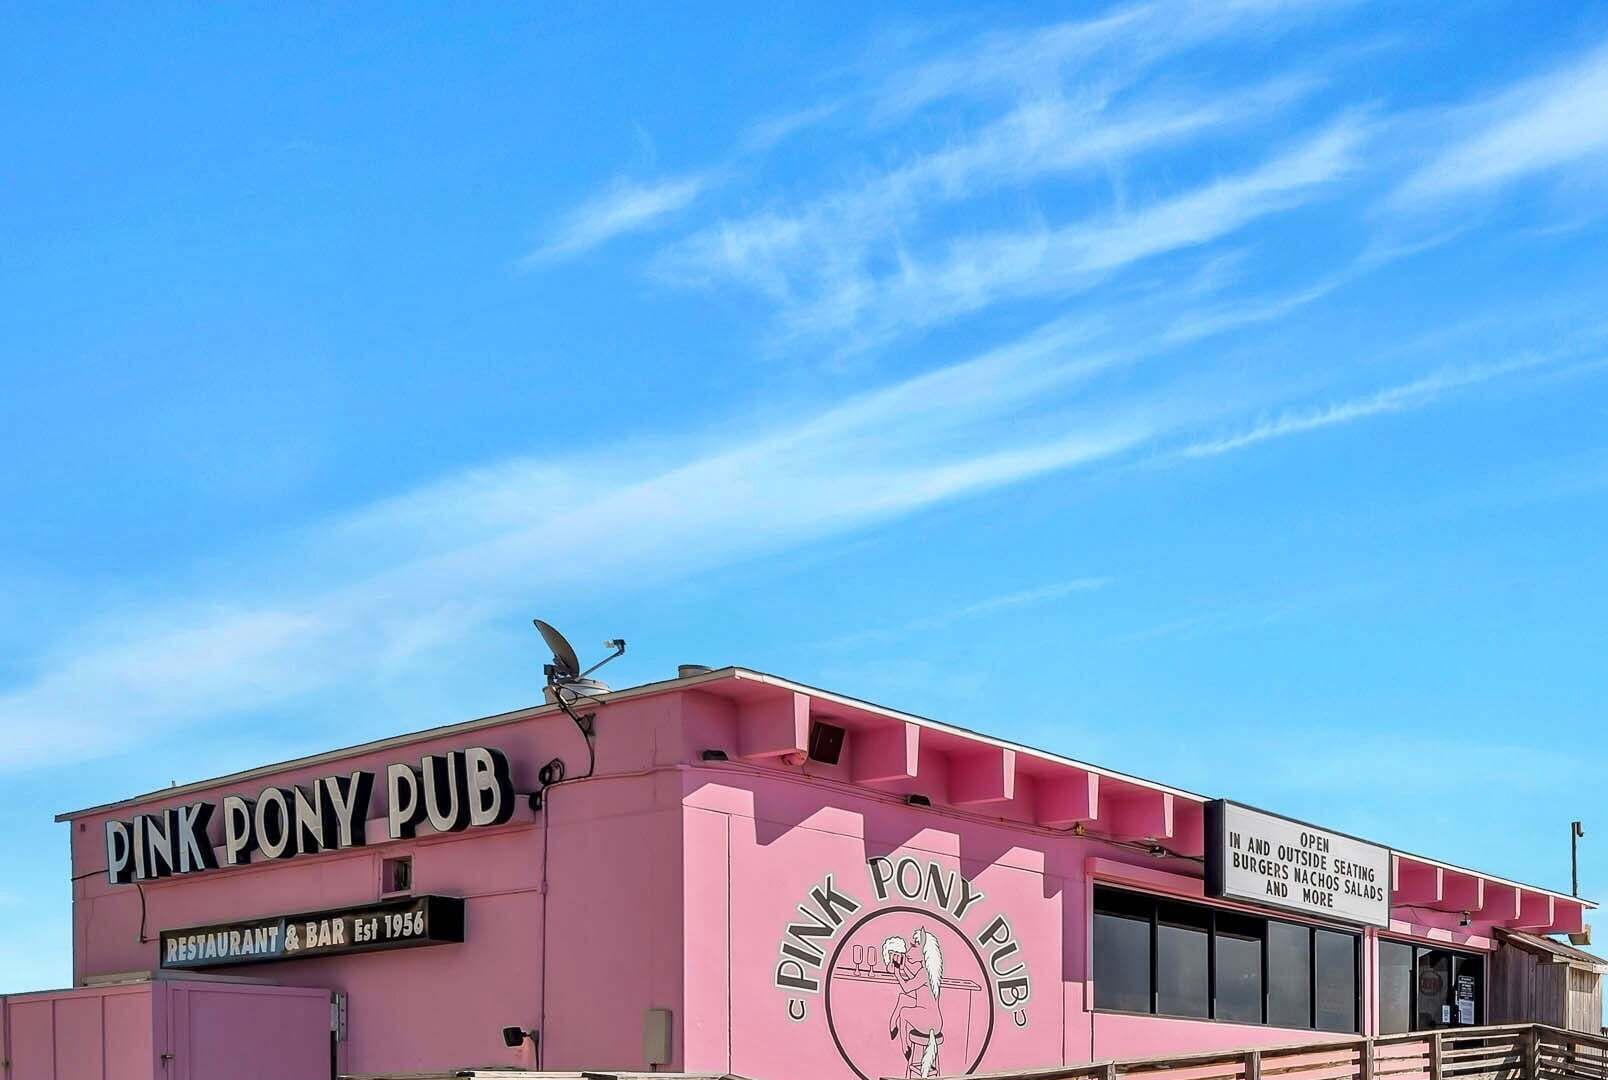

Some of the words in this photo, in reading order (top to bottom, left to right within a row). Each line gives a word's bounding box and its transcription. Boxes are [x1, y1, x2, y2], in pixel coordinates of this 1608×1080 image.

[105, 802, 212, 884] PINK
[223, 771, 374, 865] PONY
[387, 746, 513, 839] PUB
[1229, 831, 1240, 849] IN
[1248, 837, 1270, 856] AND
[1278, 845, 1327, 870] OUTSIDE
[1334, 859, 1375, 882] SEATING
[1300, 832, 1329, 853] OPEN
[1233, 852, 1289, 880] BURGERS
[1294, 867, 1339, 891] NACHOS
[1344, 880, 1383, 901] SALADS
[1266, 880, 1288, 898] AND
[1303, 888, 1333, 908] MORE
[166, 927, 279, 962] RESTAURANT
[284, 924, 300, 950] &
[306, 918, 344, 948] BAR
[354, 918, 378, 942] Est
[384, 911, 424, 938] 1956
[777, 875, 860, 991] PINK
[868, 856, 983, 919] PONY
[977, 915, 1031, 1008] PUB
